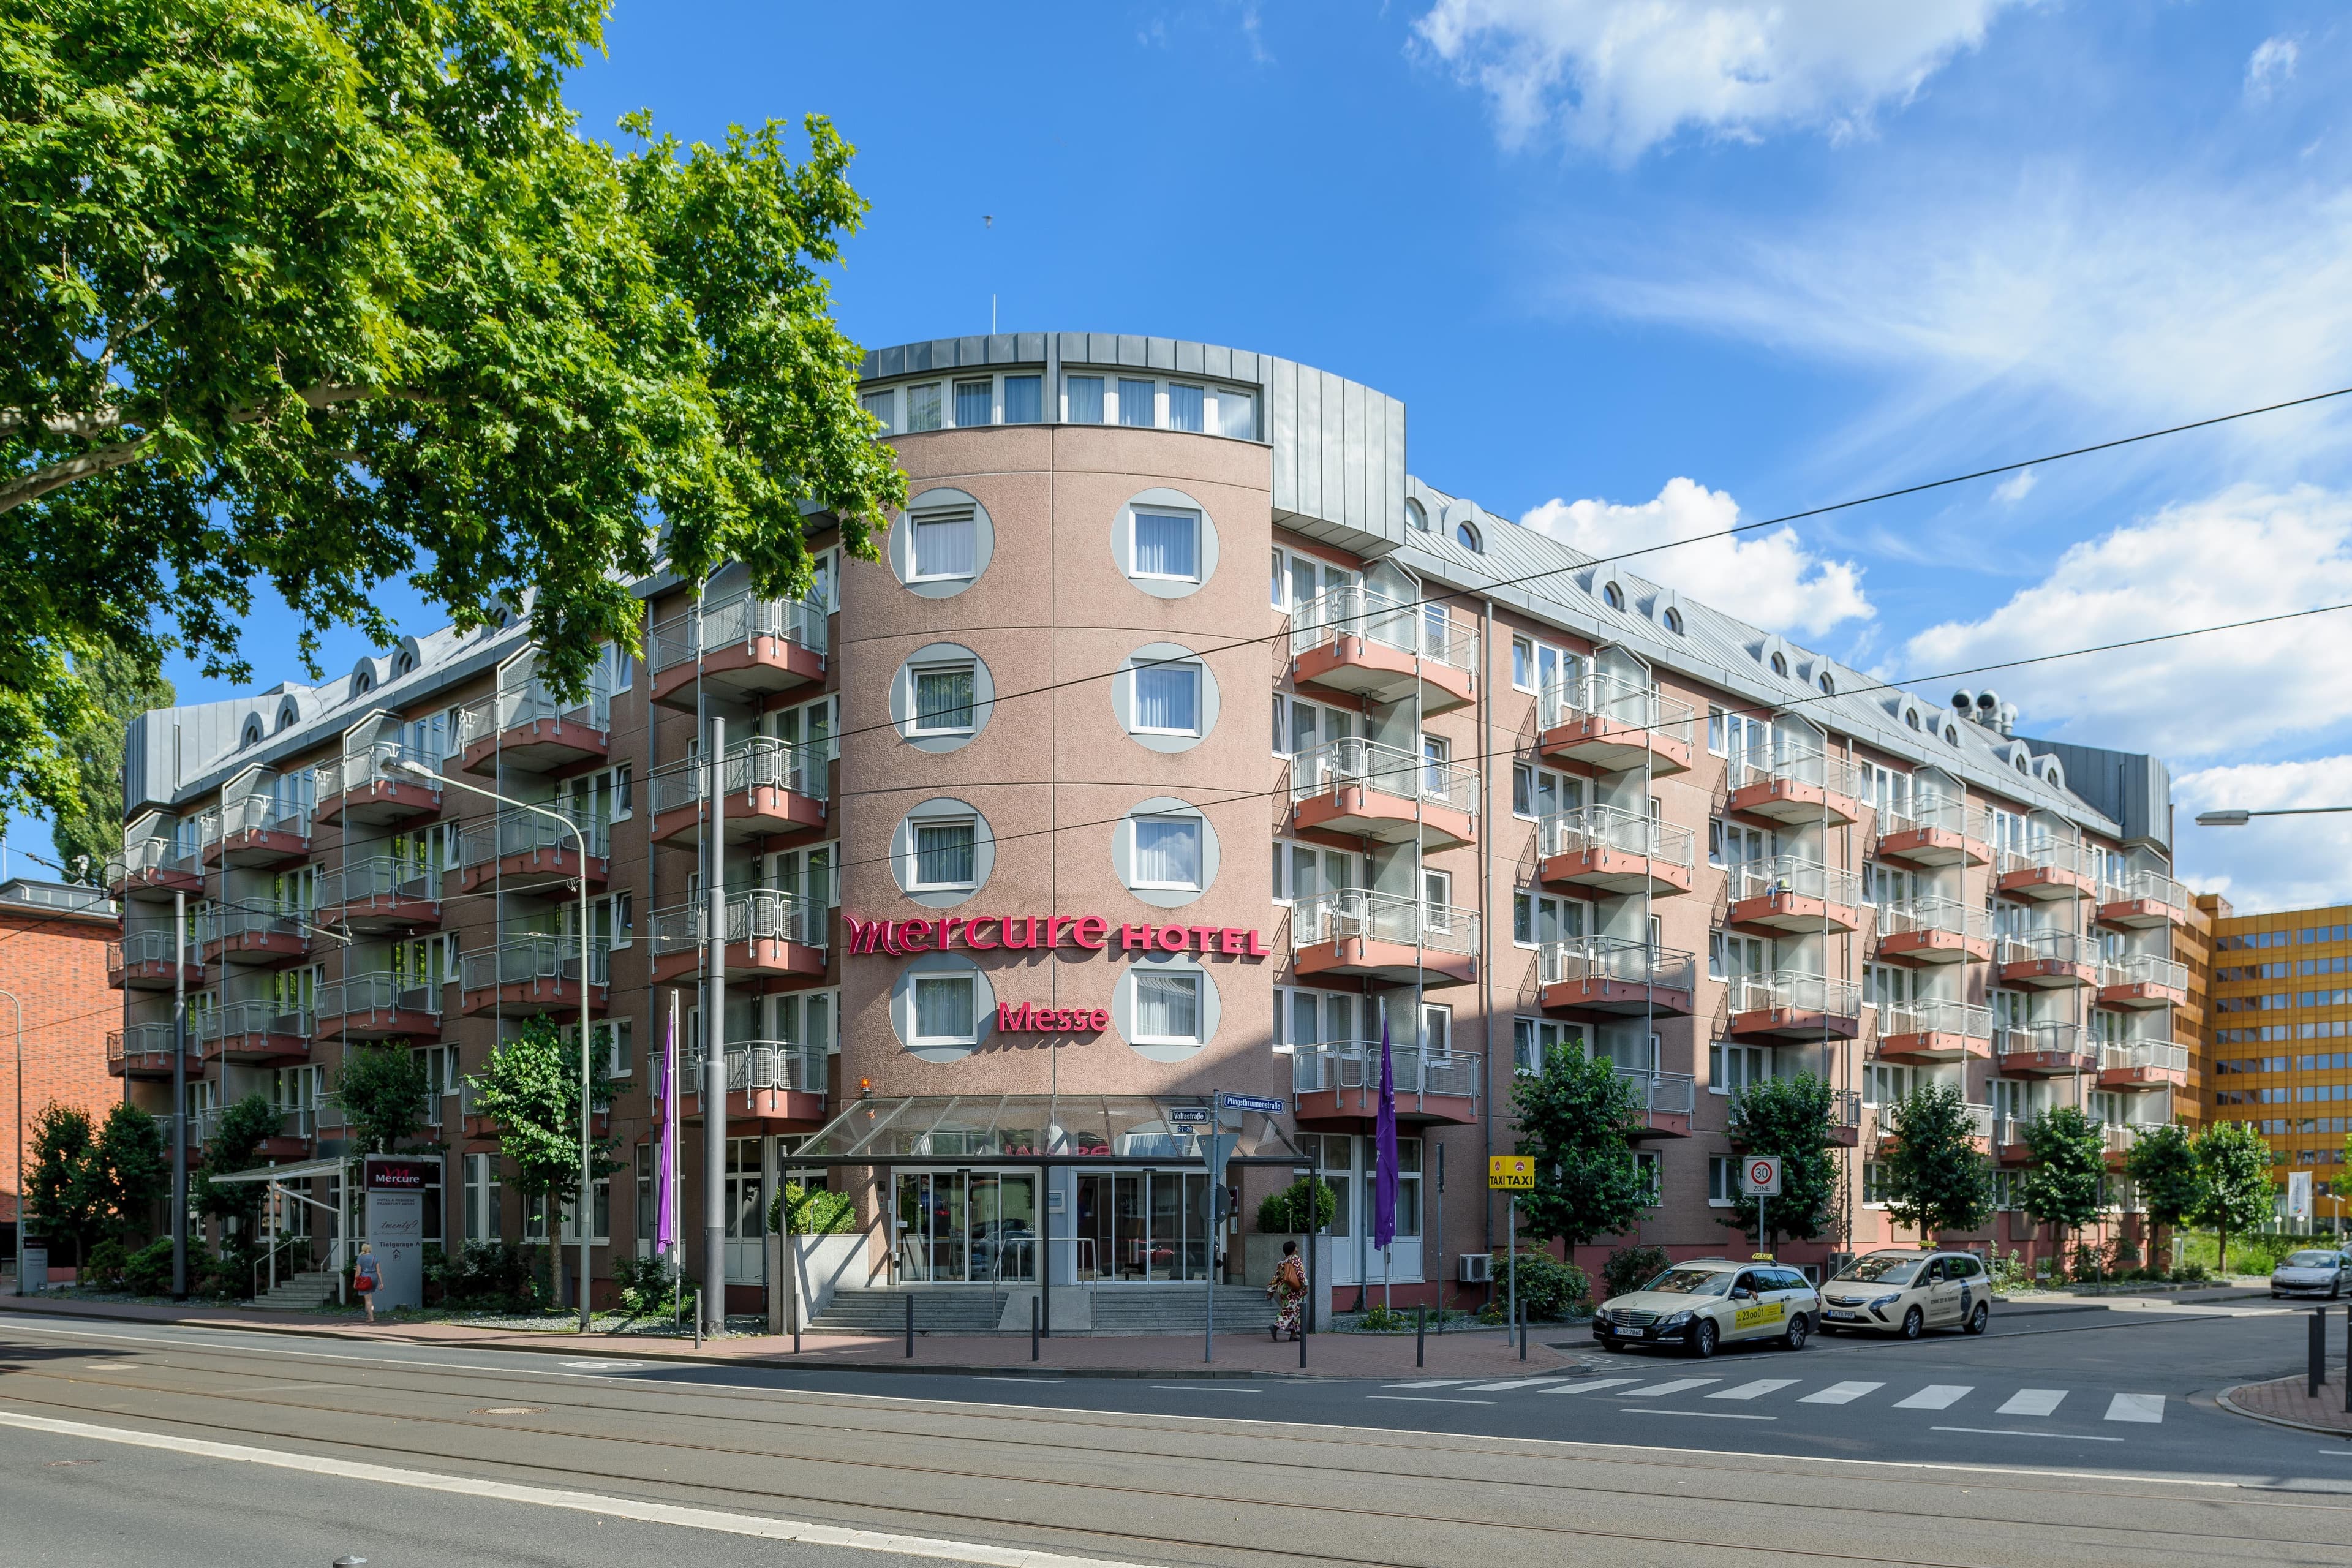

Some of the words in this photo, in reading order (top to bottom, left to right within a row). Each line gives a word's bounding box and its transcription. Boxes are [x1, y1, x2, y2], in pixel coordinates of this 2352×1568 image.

[1121, 923, 1270, 956] HOTEL
[999, 1002, 1109, 1031] Messe
[1227, 1097, 1281, 1110] Pfingstbrunnenstraße
[1174, 1111, 1204, 1120] Voltastraße
[1755, 1168, 1768, 1178] 30
[375, 1174, 420, 1183] Mercure
[1490, 1176, 1505, 1185] TAXI
[1507, 1175, 1533, 1185] TAXI
